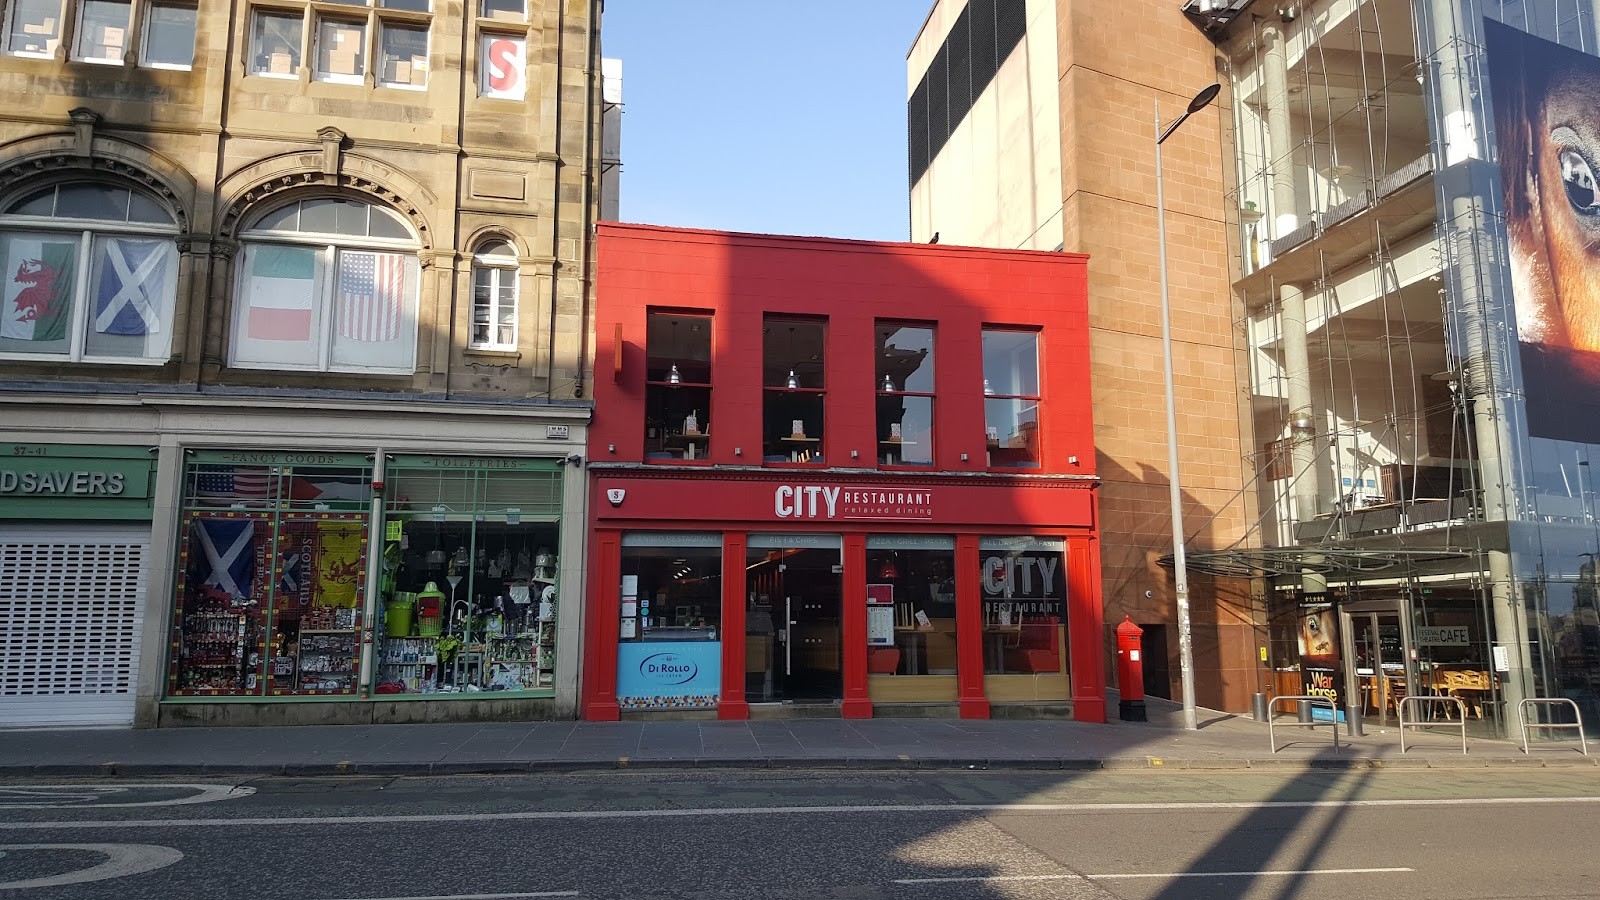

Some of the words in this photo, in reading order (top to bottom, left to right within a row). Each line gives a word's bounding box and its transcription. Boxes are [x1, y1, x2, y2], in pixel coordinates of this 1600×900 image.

[488, 38, 519, 91] S
[232, 453, 278, 463] FANCY
[285, 453, 334, 464] GOODS
[433, 458, 517, 468] TOILETRIES
[775, 485, 841, 518] CITY
[844, 492, 932, 505] RESTAURANT
[844, 506, 890, 514] relaxed
[896, 507, 933, 516] dining
[300, 538, 313, 606] SCOTLAND
[983, 556, 1058, 595] CITY
[985, 602, 1060, 613] RESTAURANT
[1311, 671, 1333, 688] War
[1306, 683, 1338, 702] Horse
